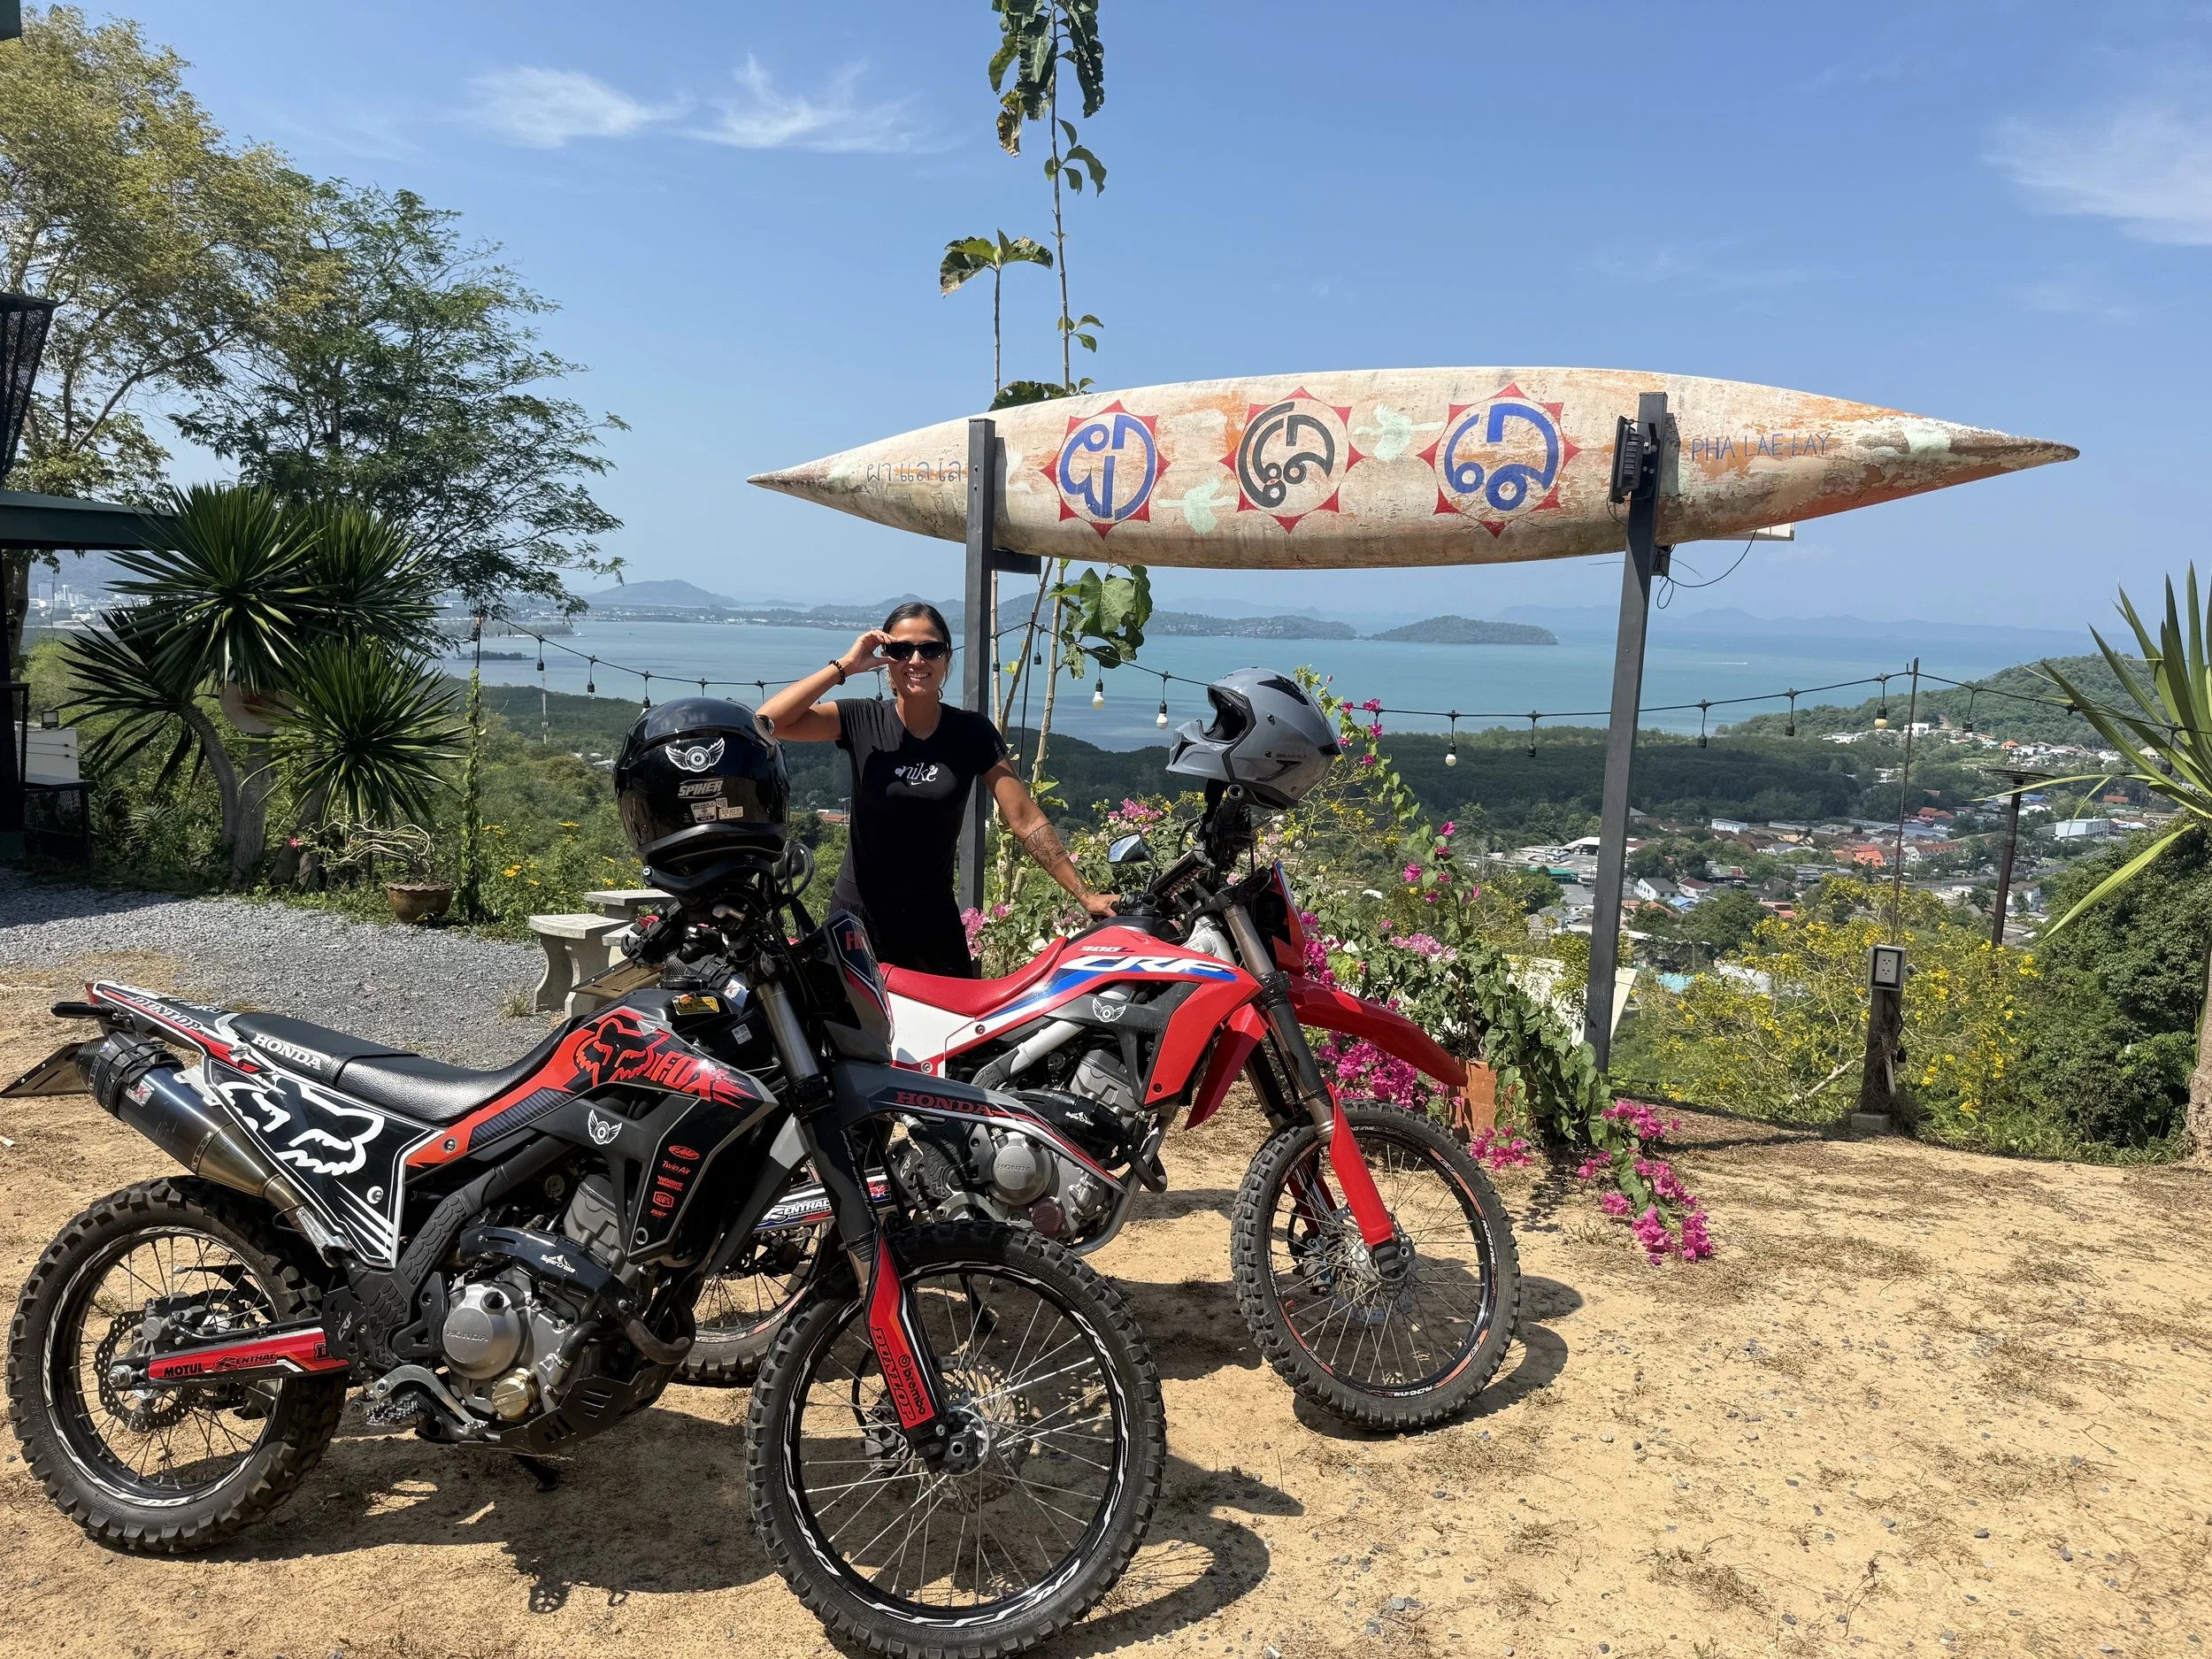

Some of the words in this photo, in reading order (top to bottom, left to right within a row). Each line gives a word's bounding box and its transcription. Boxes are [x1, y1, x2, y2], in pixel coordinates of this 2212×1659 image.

[1692, 435, 1736, 462] PHA
[1745, 433, 1784, 457] LAE
[1792, 432, 1831, 457] LAY
[897, 762, 939, 782] nike
[678, 780, 724, 797] SPIKER
[1059, 955, 1239, 973] CRF
[132, 996, 203, 1031] DUNLOP
[251, 1032, 322, 1071] HONDA
[650, 1050, 729, 1102] FOX
[895, 1091, 994, 1117] HONDA
[662, 1160, 680, 1171] Twin
[679, 1166, 690, 1175] Air
[997, 1163, 1032, 1173] HONDA
[656, 1194, 671, 1205] 100%
[337, 1310, 353, 1342] CRF
[446, 1328, 489, 1342] HONDA
[164, 1363, 203, 1378] MOTUL
[871, 1326, 917, 1421] DUNLOP
[903, 1367, 926, 1416] brembo
